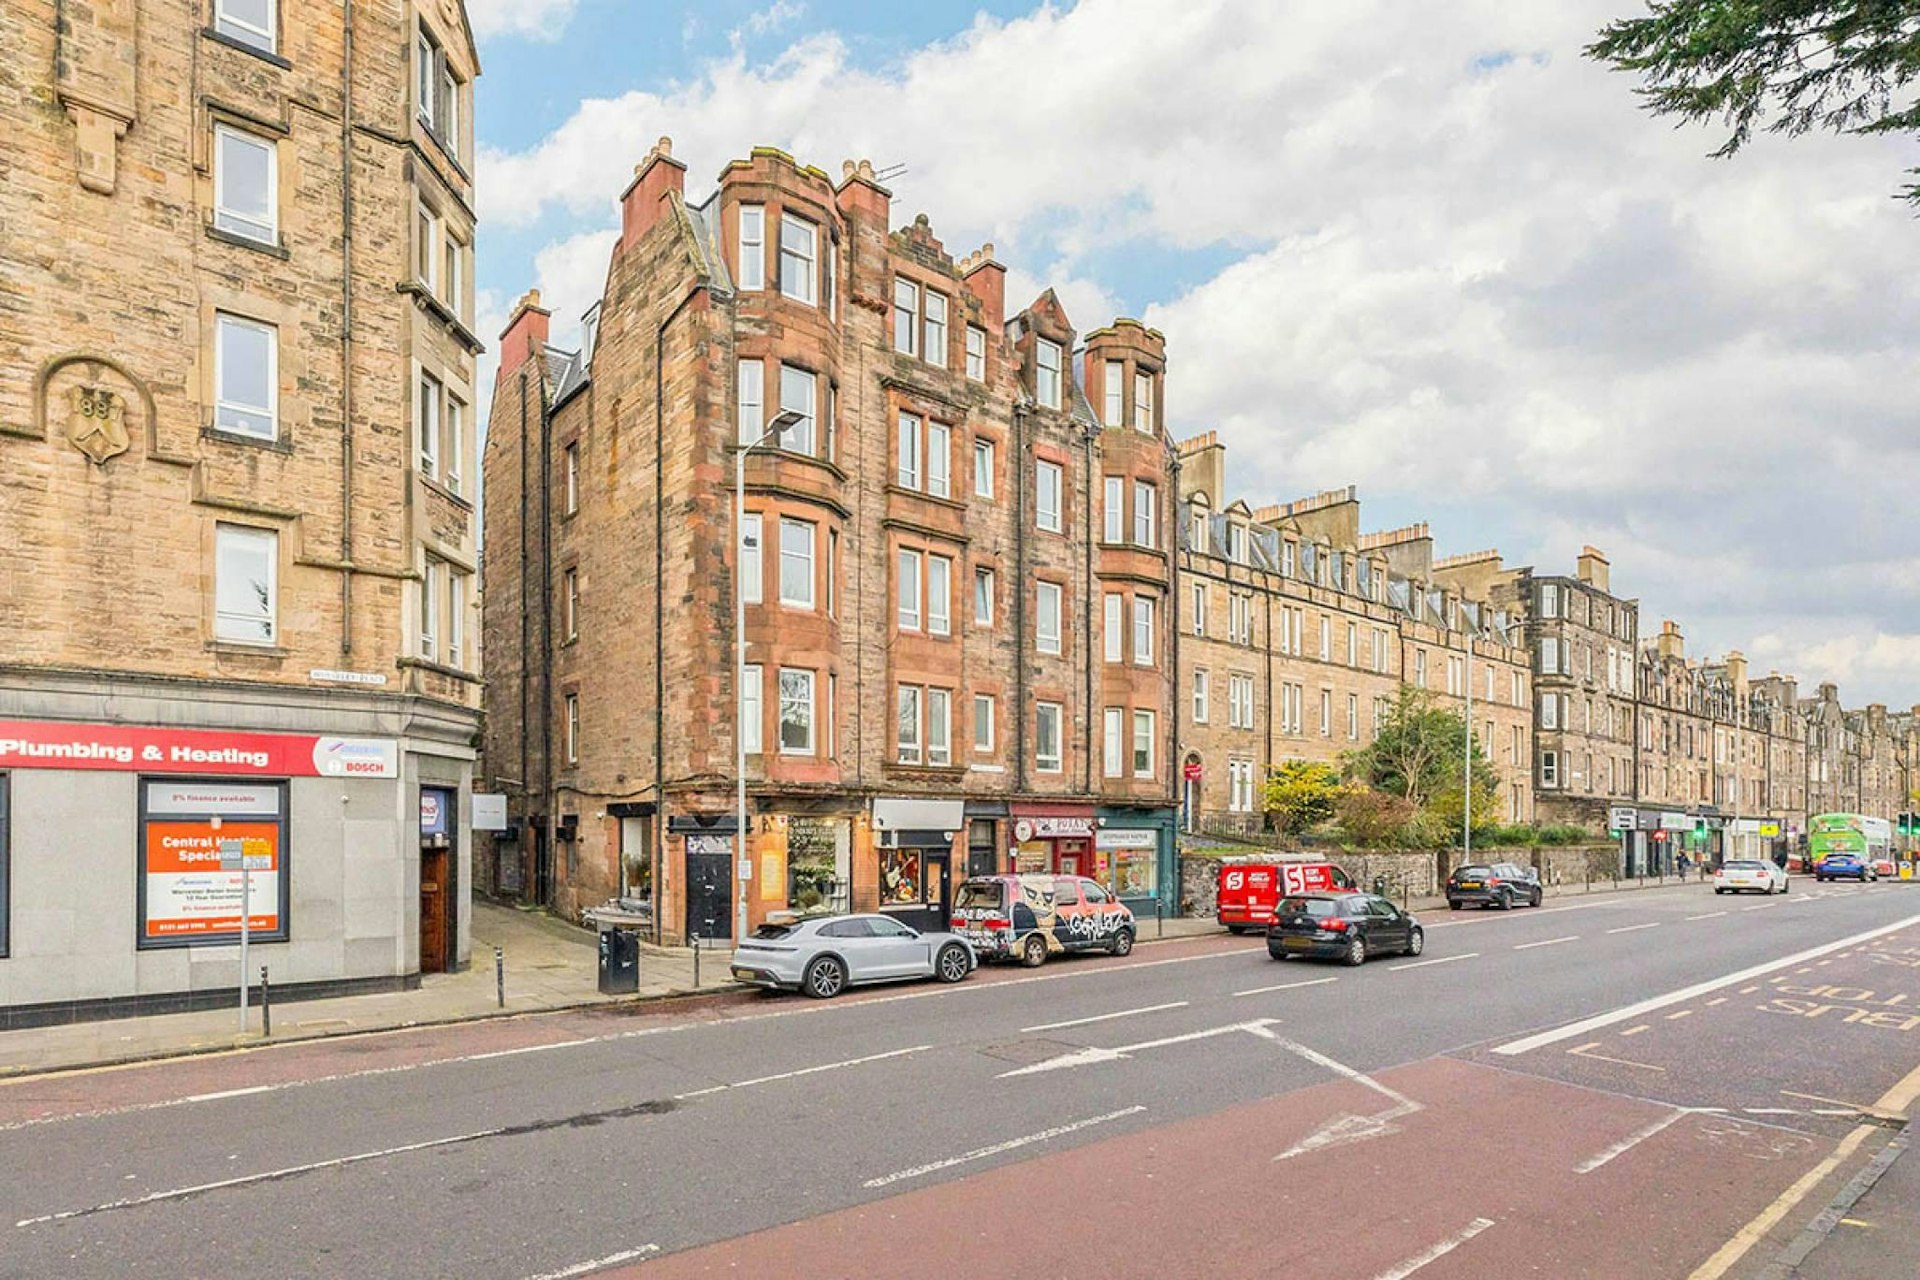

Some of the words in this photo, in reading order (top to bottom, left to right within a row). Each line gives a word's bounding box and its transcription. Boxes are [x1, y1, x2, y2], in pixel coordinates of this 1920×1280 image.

[0, 740, 134, 763] Plumbing
[142, 745, 163, 761] &
[171, 746, 269, 767] Heating
[346, 763, 384, 772] BOSCH
[162, 836, 213, 848] Central
[1755, 999, 1920, 1031] BUS
